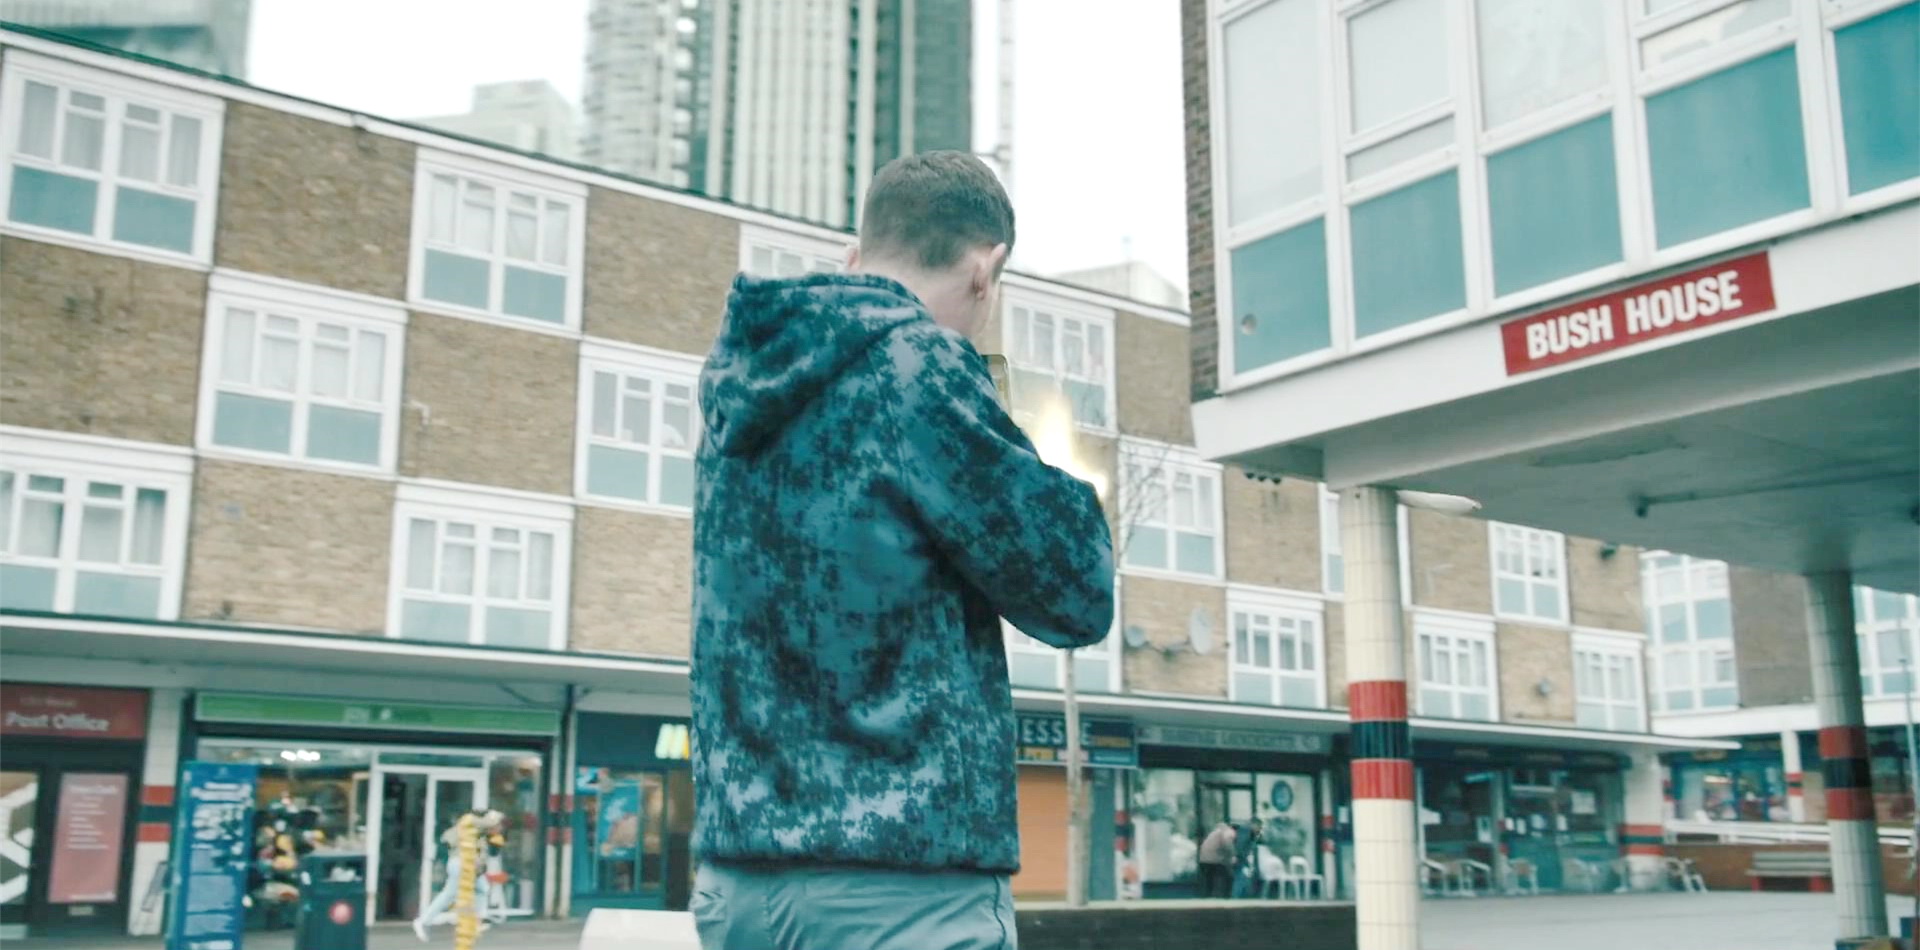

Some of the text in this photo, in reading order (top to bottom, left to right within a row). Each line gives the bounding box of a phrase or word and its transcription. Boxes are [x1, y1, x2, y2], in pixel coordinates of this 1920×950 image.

[1526, 269, 1740, 360] BUSH HOUSE
[53, 712, 111, 732] Office
